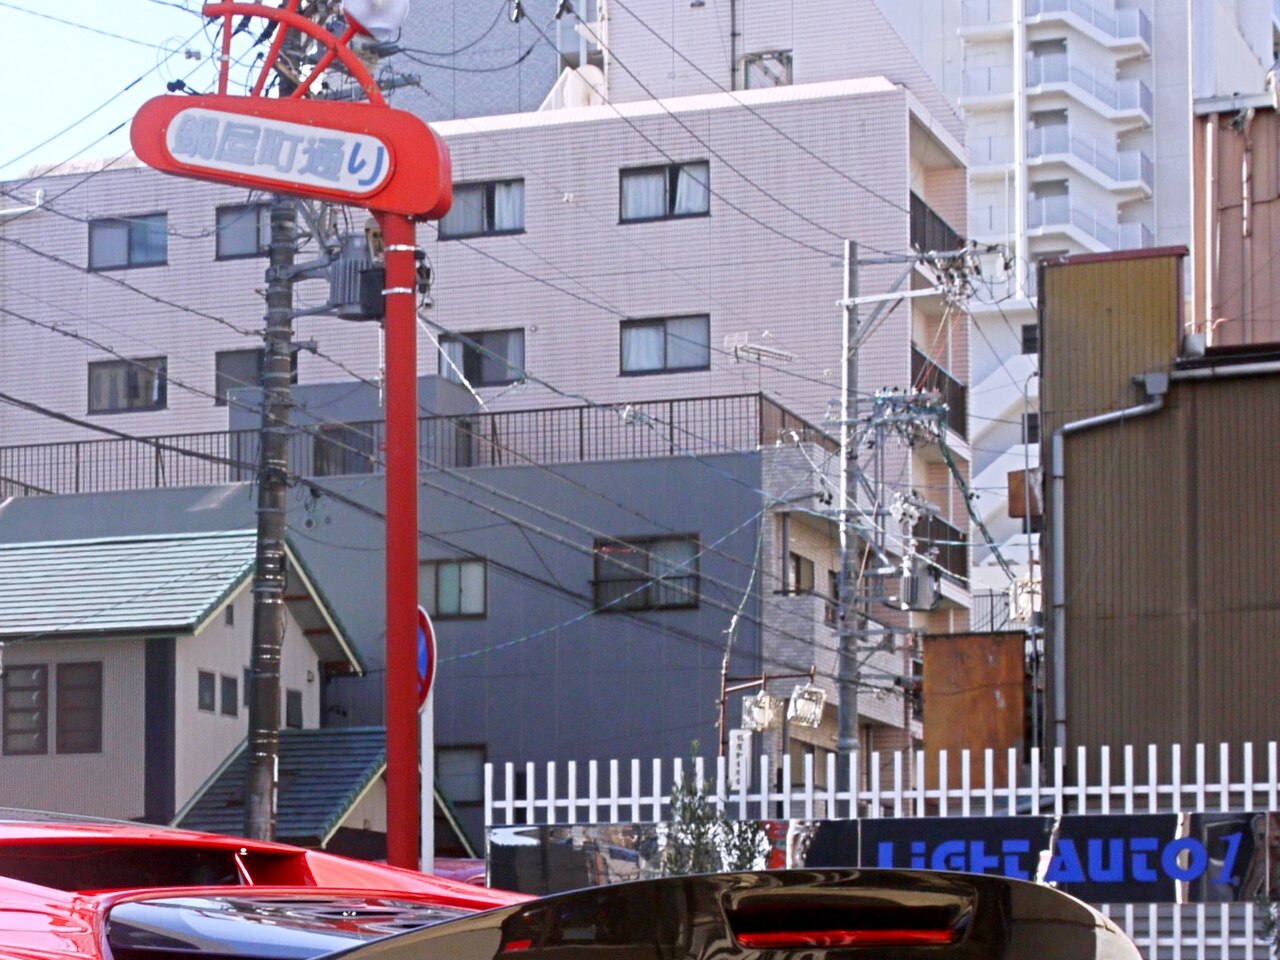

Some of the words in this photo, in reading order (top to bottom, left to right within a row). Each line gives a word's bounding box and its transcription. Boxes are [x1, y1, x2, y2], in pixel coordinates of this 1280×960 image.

[172, 113, 384, 187] 鍋屋町通り
